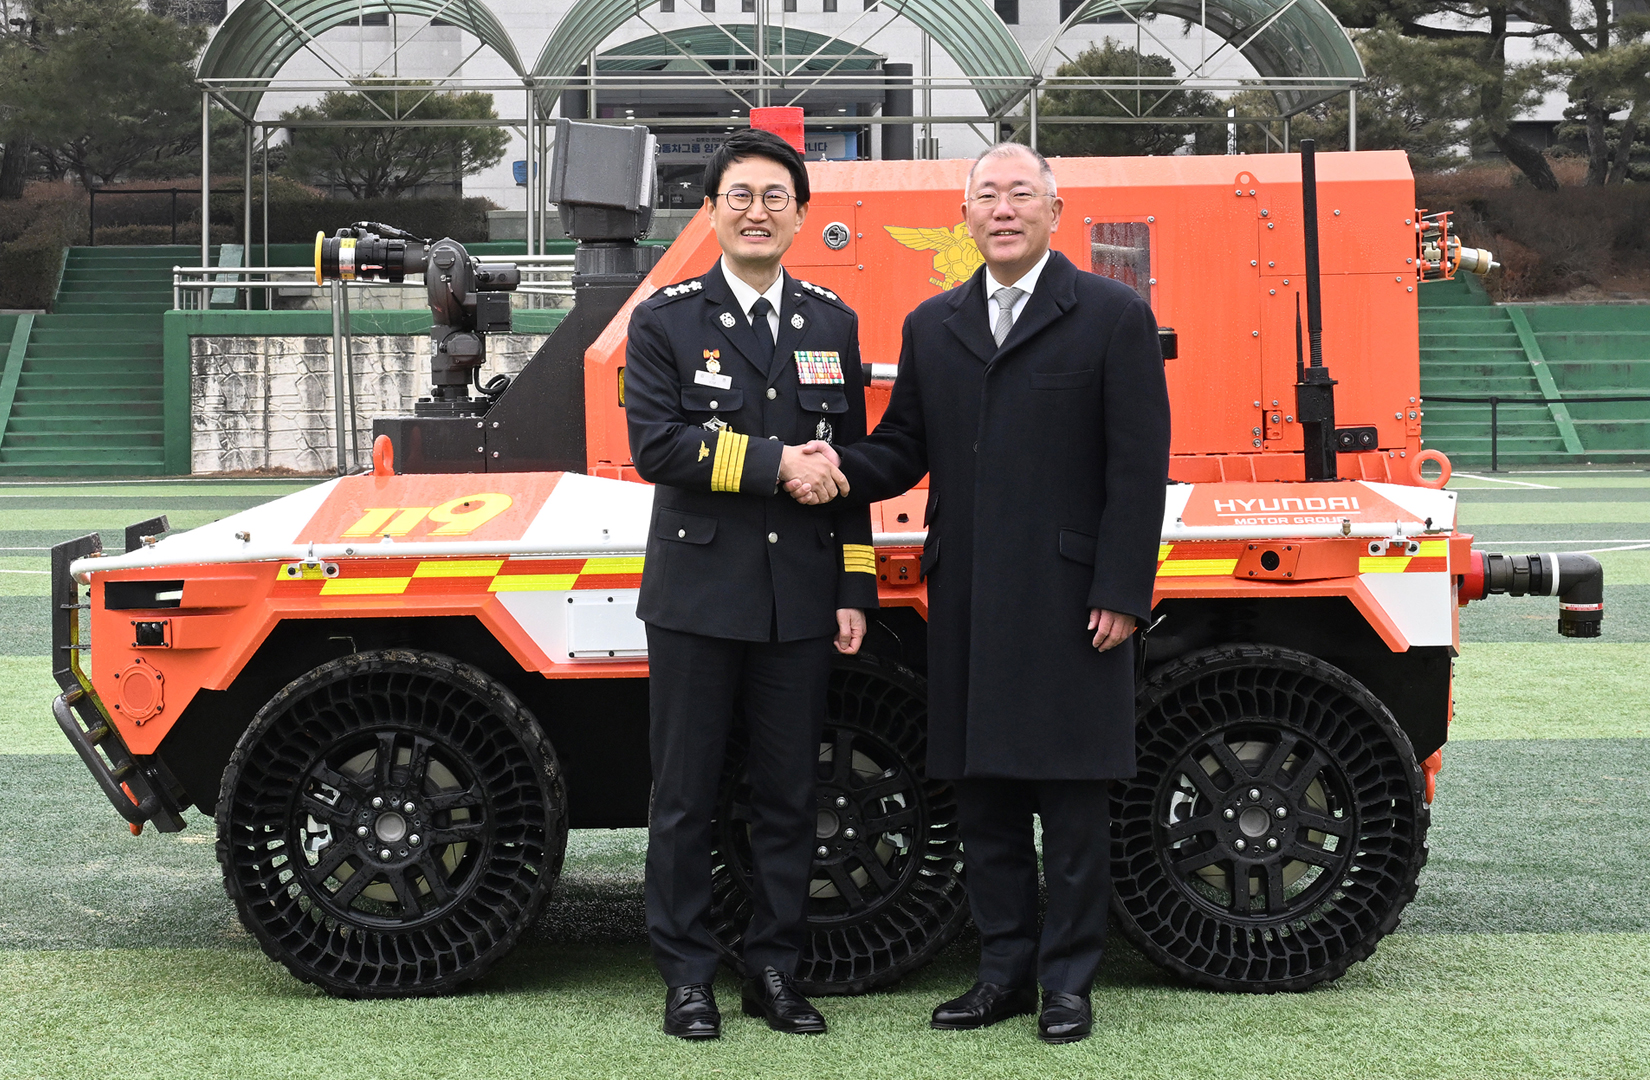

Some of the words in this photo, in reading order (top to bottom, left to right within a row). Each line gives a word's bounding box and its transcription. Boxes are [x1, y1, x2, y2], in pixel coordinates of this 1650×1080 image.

[1214, 497, 1360, 512] HYUNDAI
[340, 492, 513, 538] 119
[1234, 517, 1289, 525] MOTOR
[1293, 516, 1348, 524] GROUP
